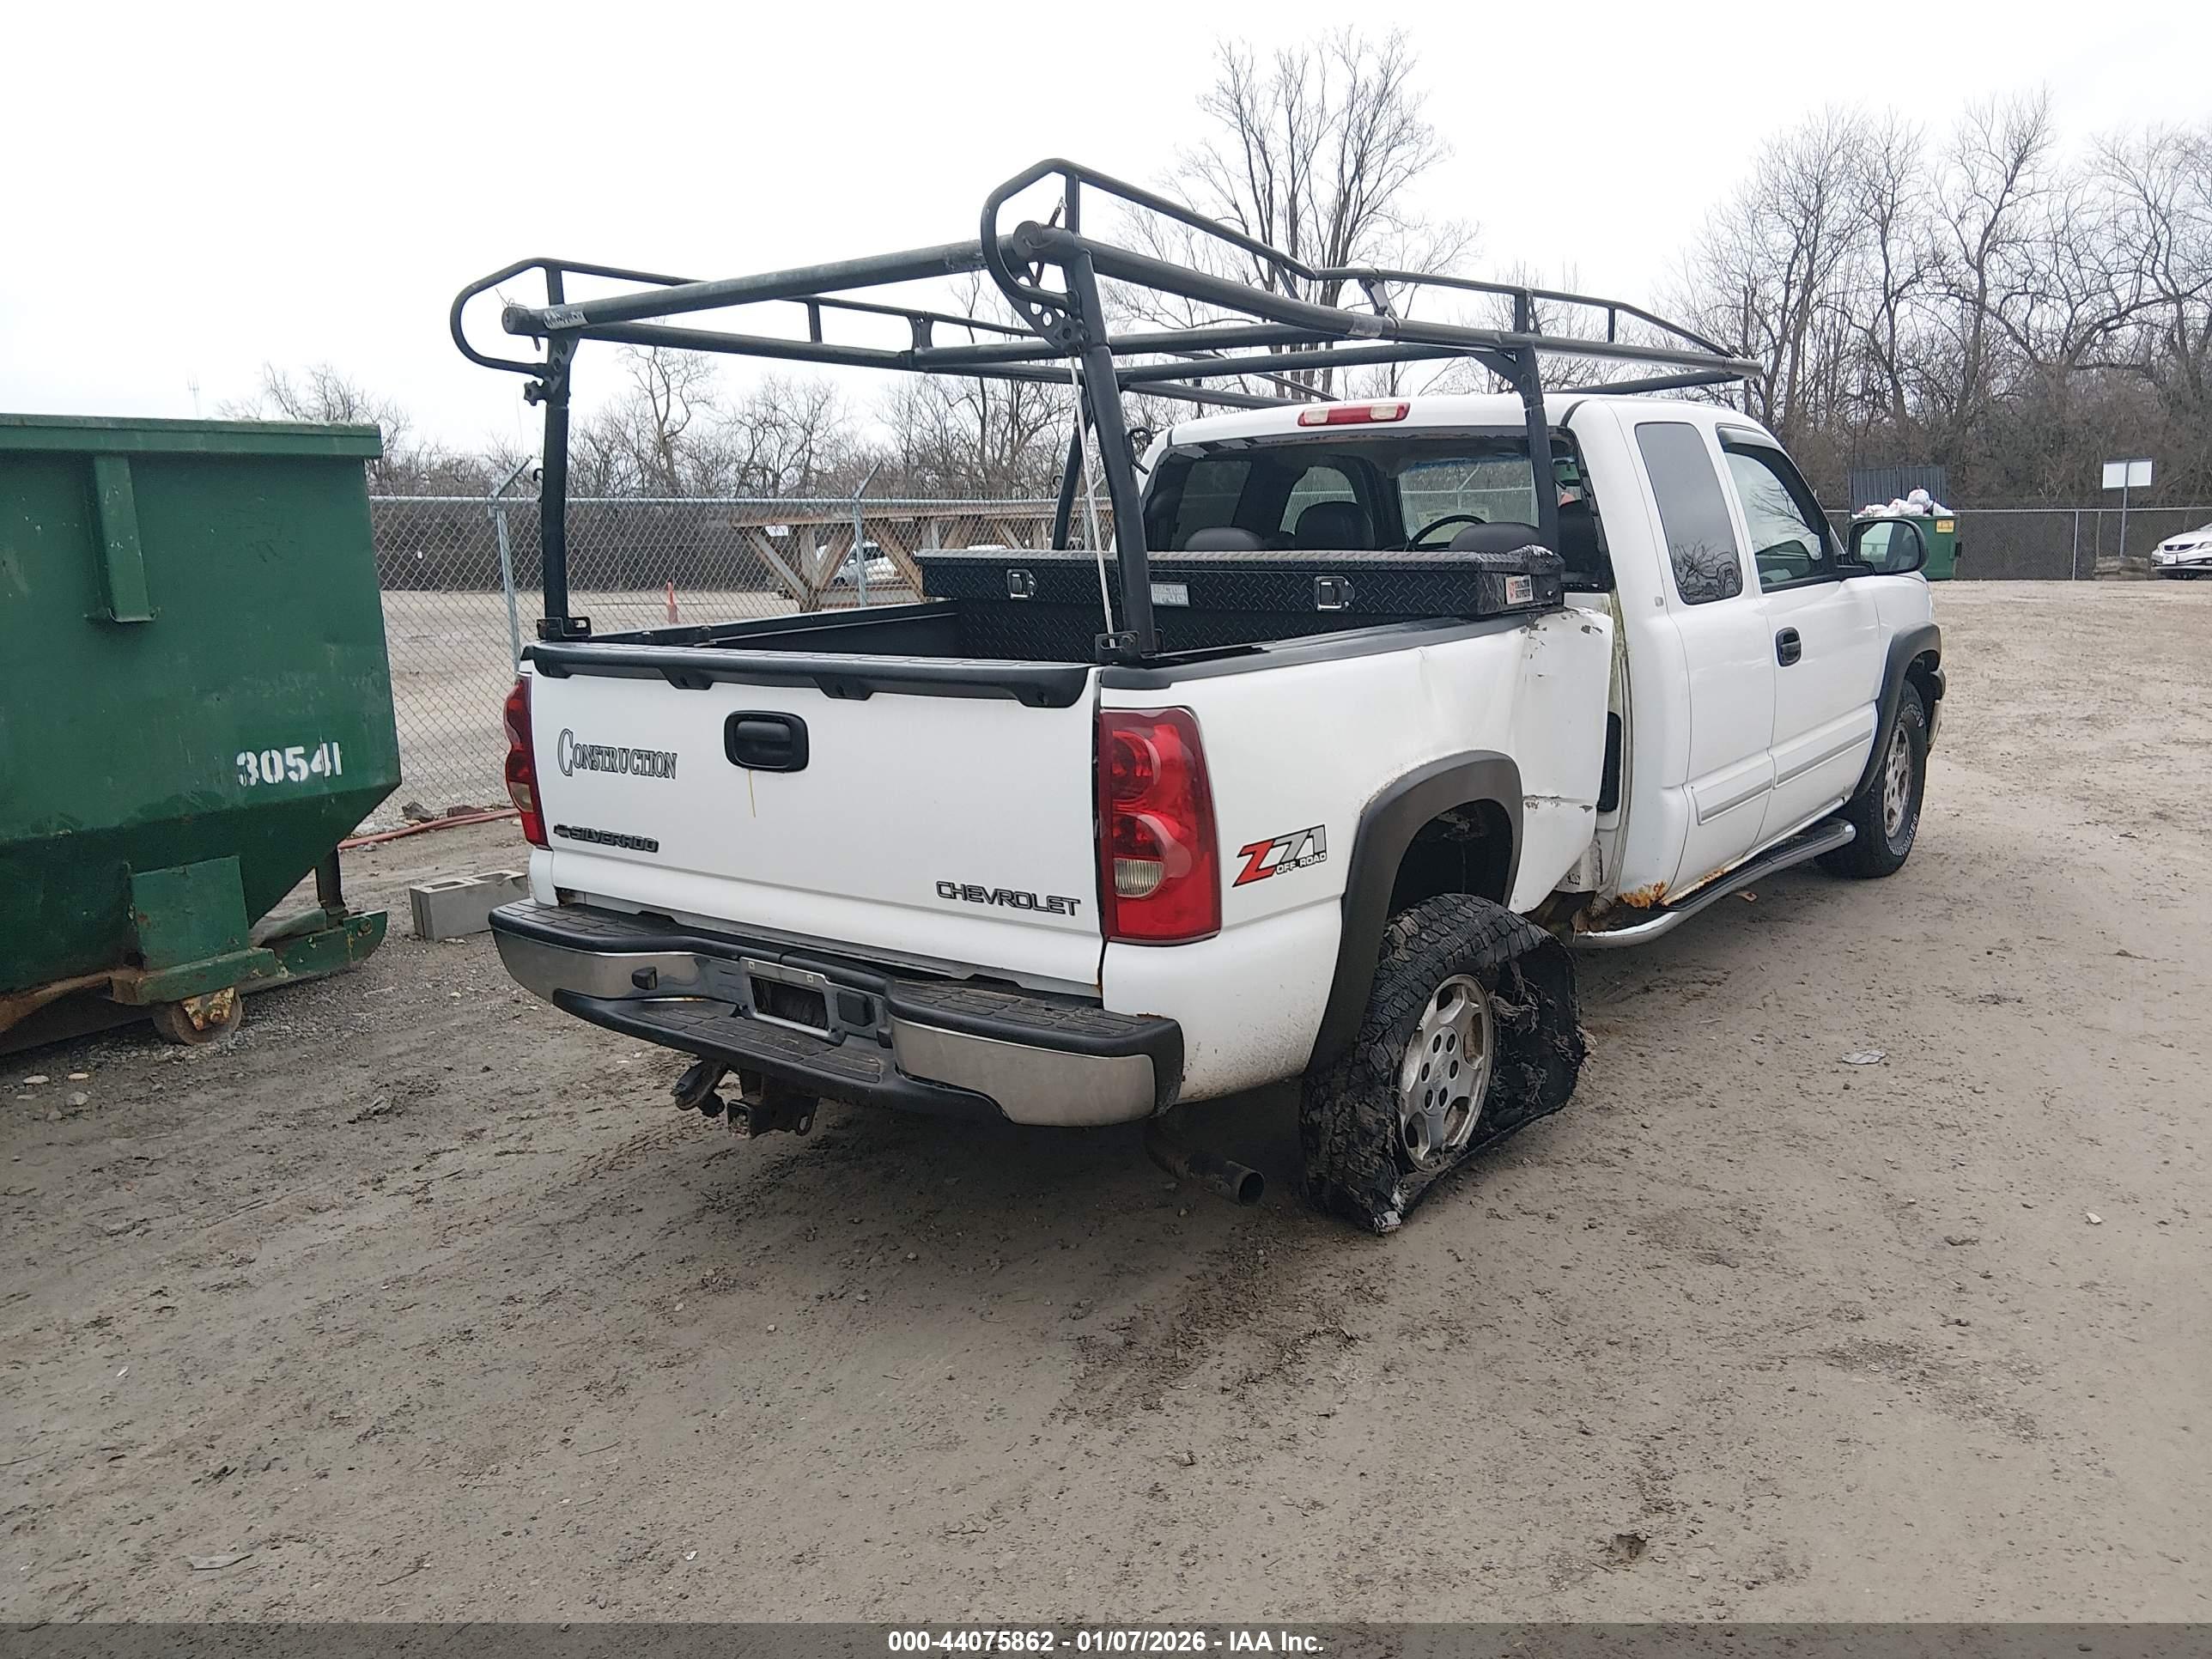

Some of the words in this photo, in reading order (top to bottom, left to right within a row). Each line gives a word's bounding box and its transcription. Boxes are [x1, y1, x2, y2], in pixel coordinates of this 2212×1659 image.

[236, 742, 343, 787] 30541
[557, 728, 678, 780] CONSTRUCTION
[570, 825, 659, 853] SILVERADO
[1231, 823, 1328, 888] Z71
[1276, 860, 1297, 875] OFF
[1299, 853, 1328, 868] ROAD
[936, 880, 1081, 916] CHEVROLET
